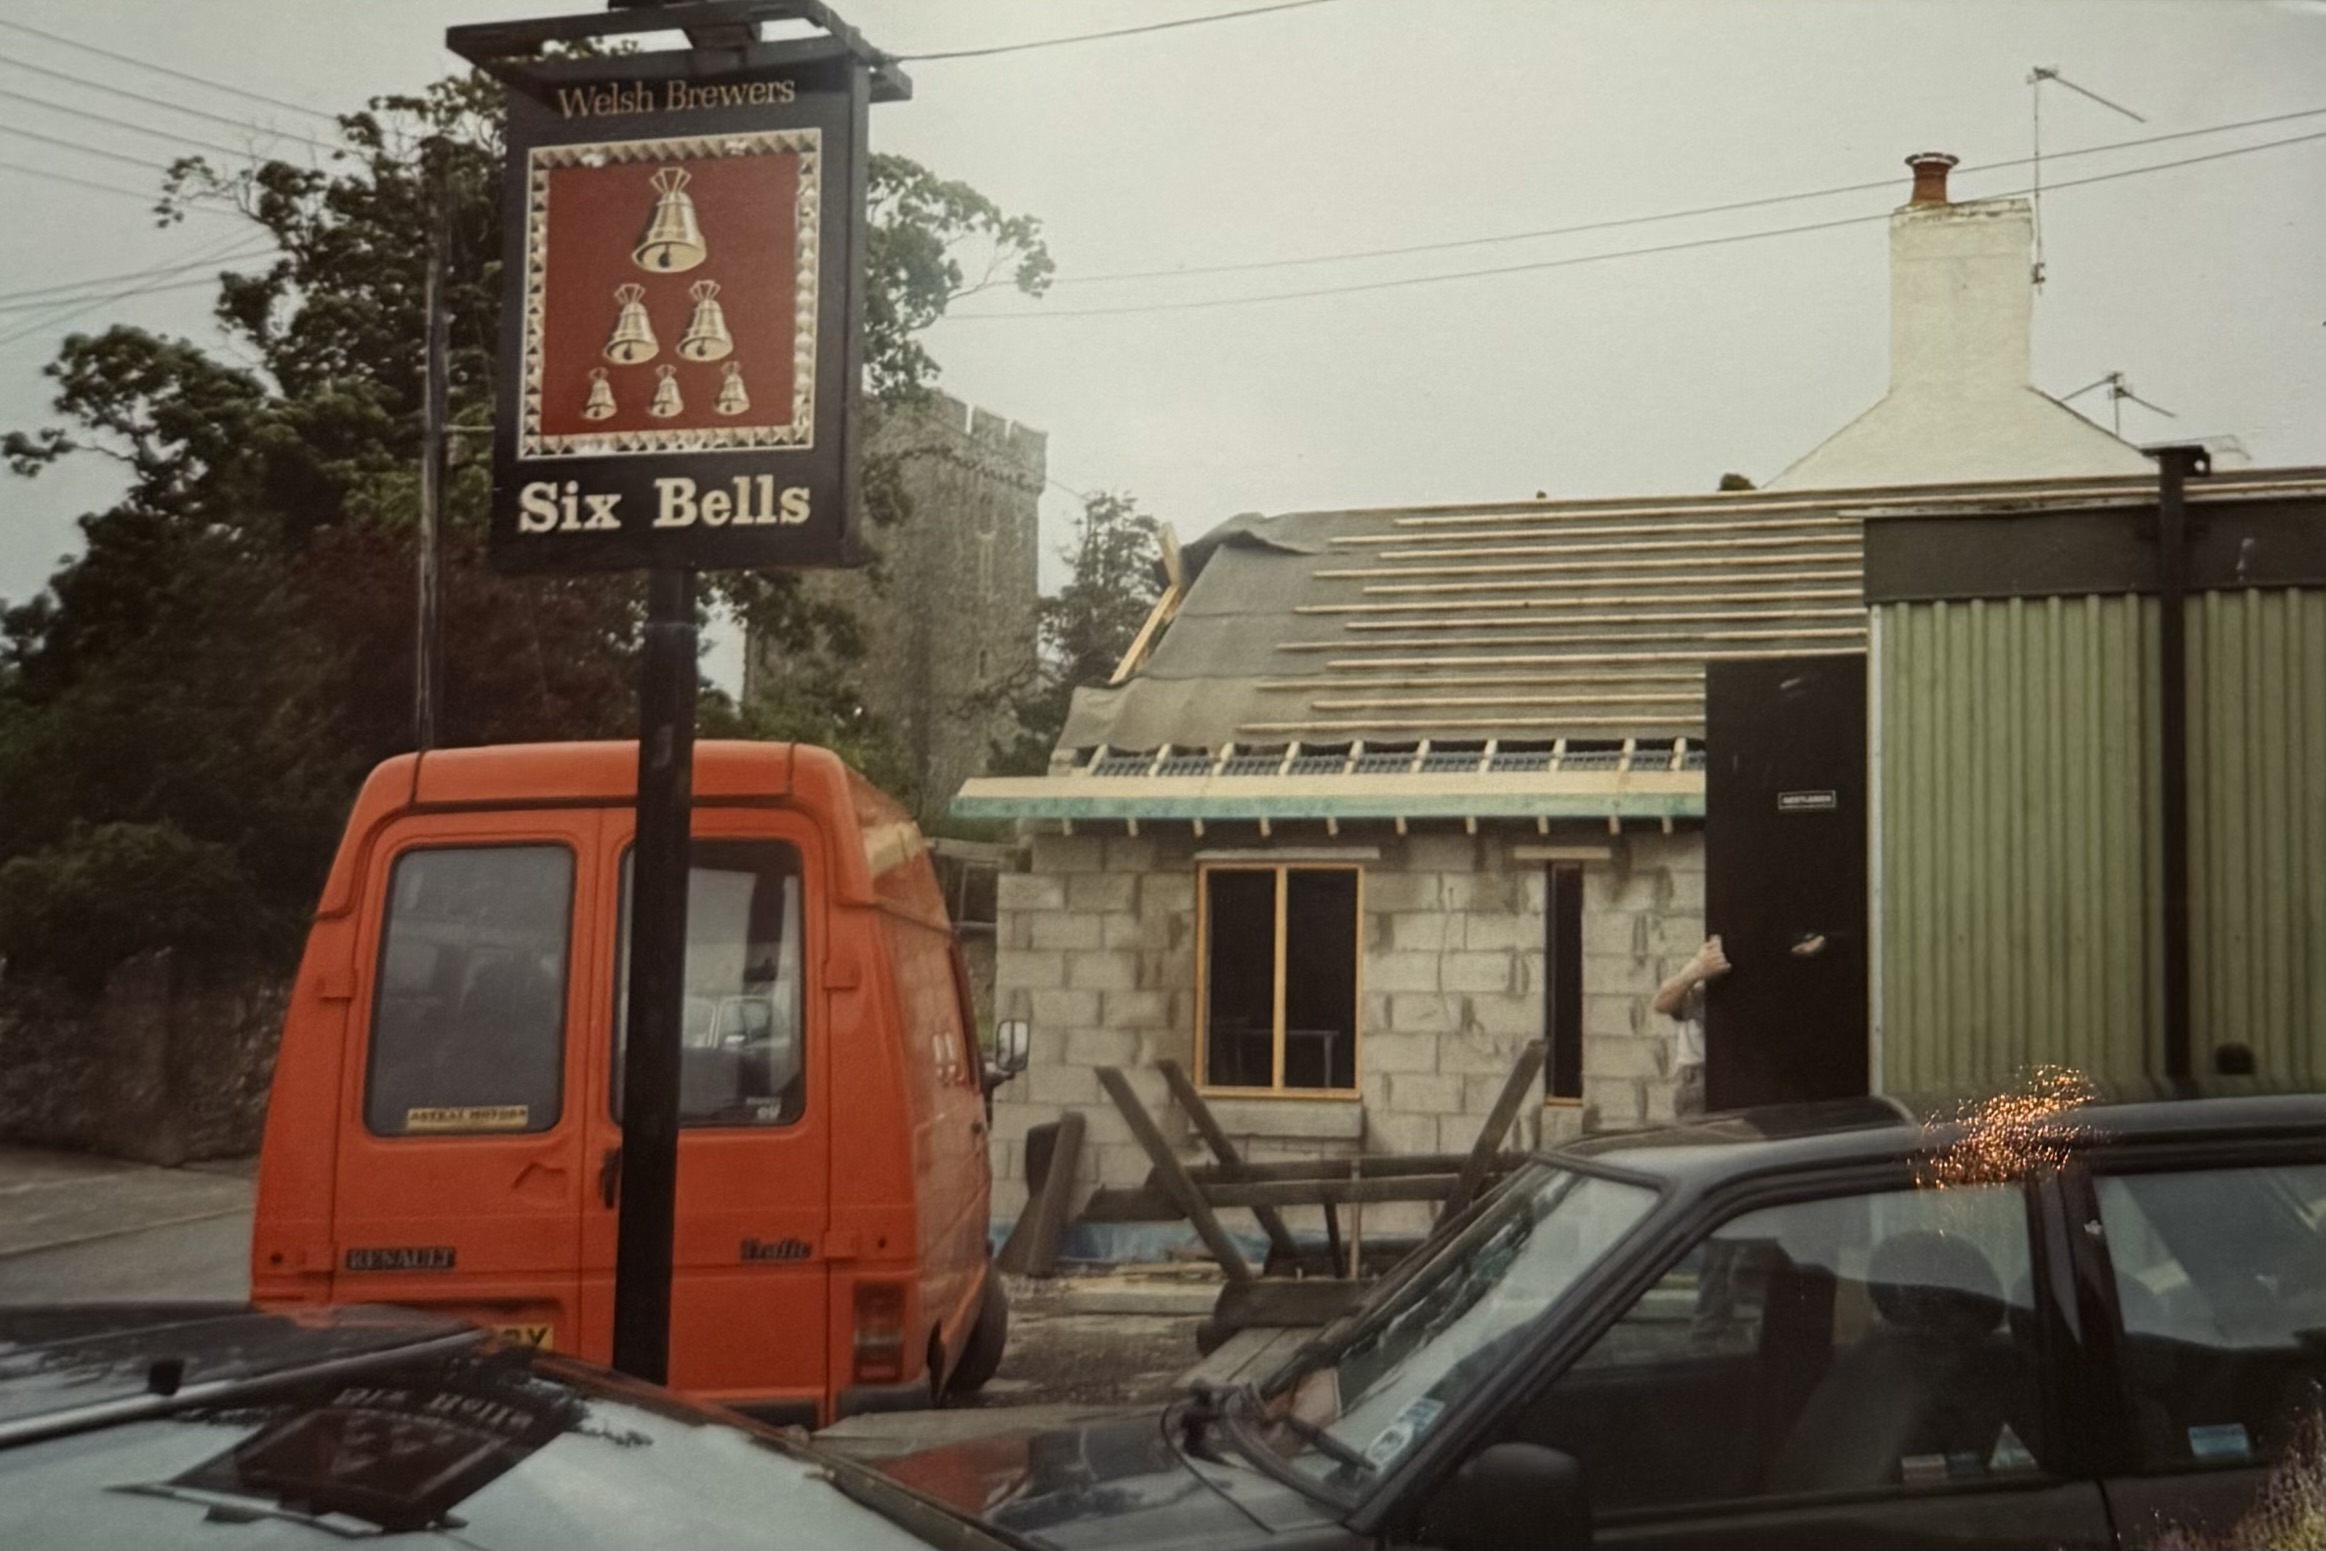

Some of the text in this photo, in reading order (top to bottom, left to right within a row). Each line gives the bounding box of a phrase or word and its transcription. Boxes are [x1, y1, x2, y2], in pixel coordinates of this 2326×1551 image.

[557, 79, 796, 119] Welsh Brewers
[518, 474, 811, 532] Six Bells
[348, 1249, 454, 1270] RENAULT
